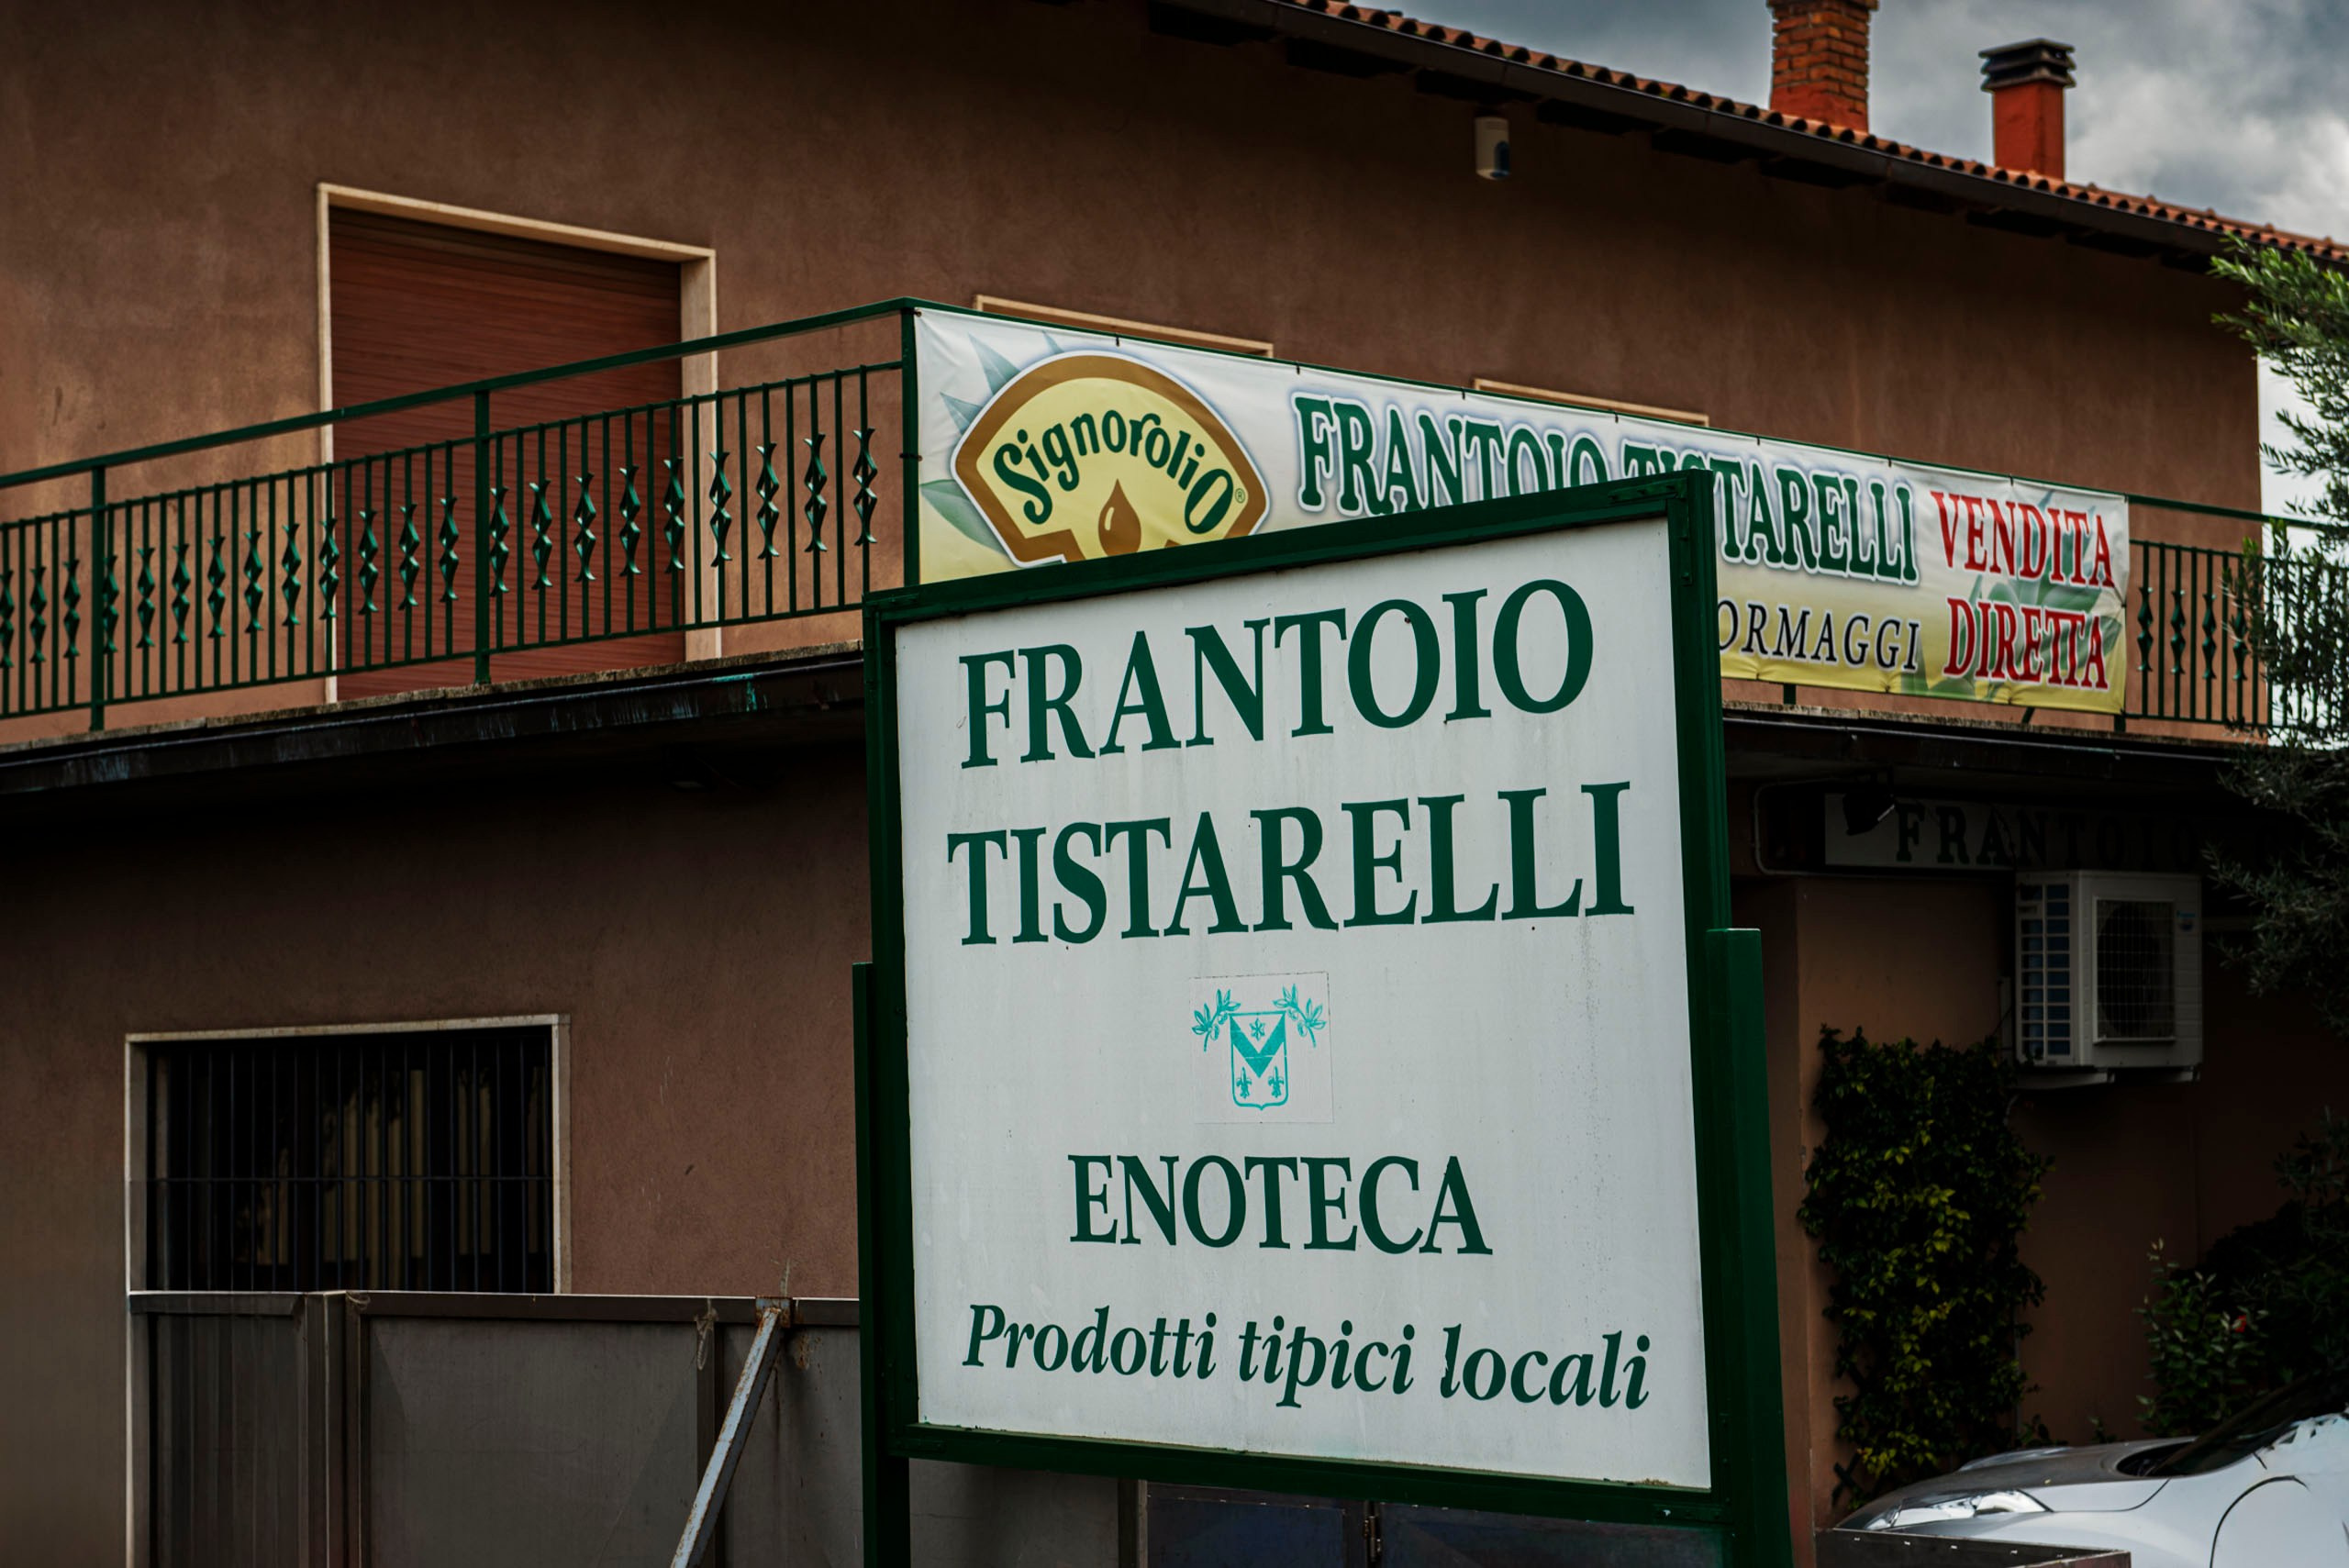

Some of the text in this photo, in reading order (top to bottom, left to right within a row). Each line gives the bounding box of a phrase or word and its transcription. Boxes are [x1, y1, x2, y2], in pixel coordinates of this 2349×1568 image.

[1624, 444, 1918, 583] TARELLI
[1930, 491, 2115, 588] VENDITA
[959, 579, 1594, 769] FRANTOIO
[1718, 600, 1919, 671] ORMAGGI
[1943, 597, 2109, 690] DIRETTA
[947, 781, 1635, 945] TISTARELLI
[1068, 1155, 1493, 1255] ENOTECA
[963, 1305, 1650, 1409] Prodotti tipici locali
